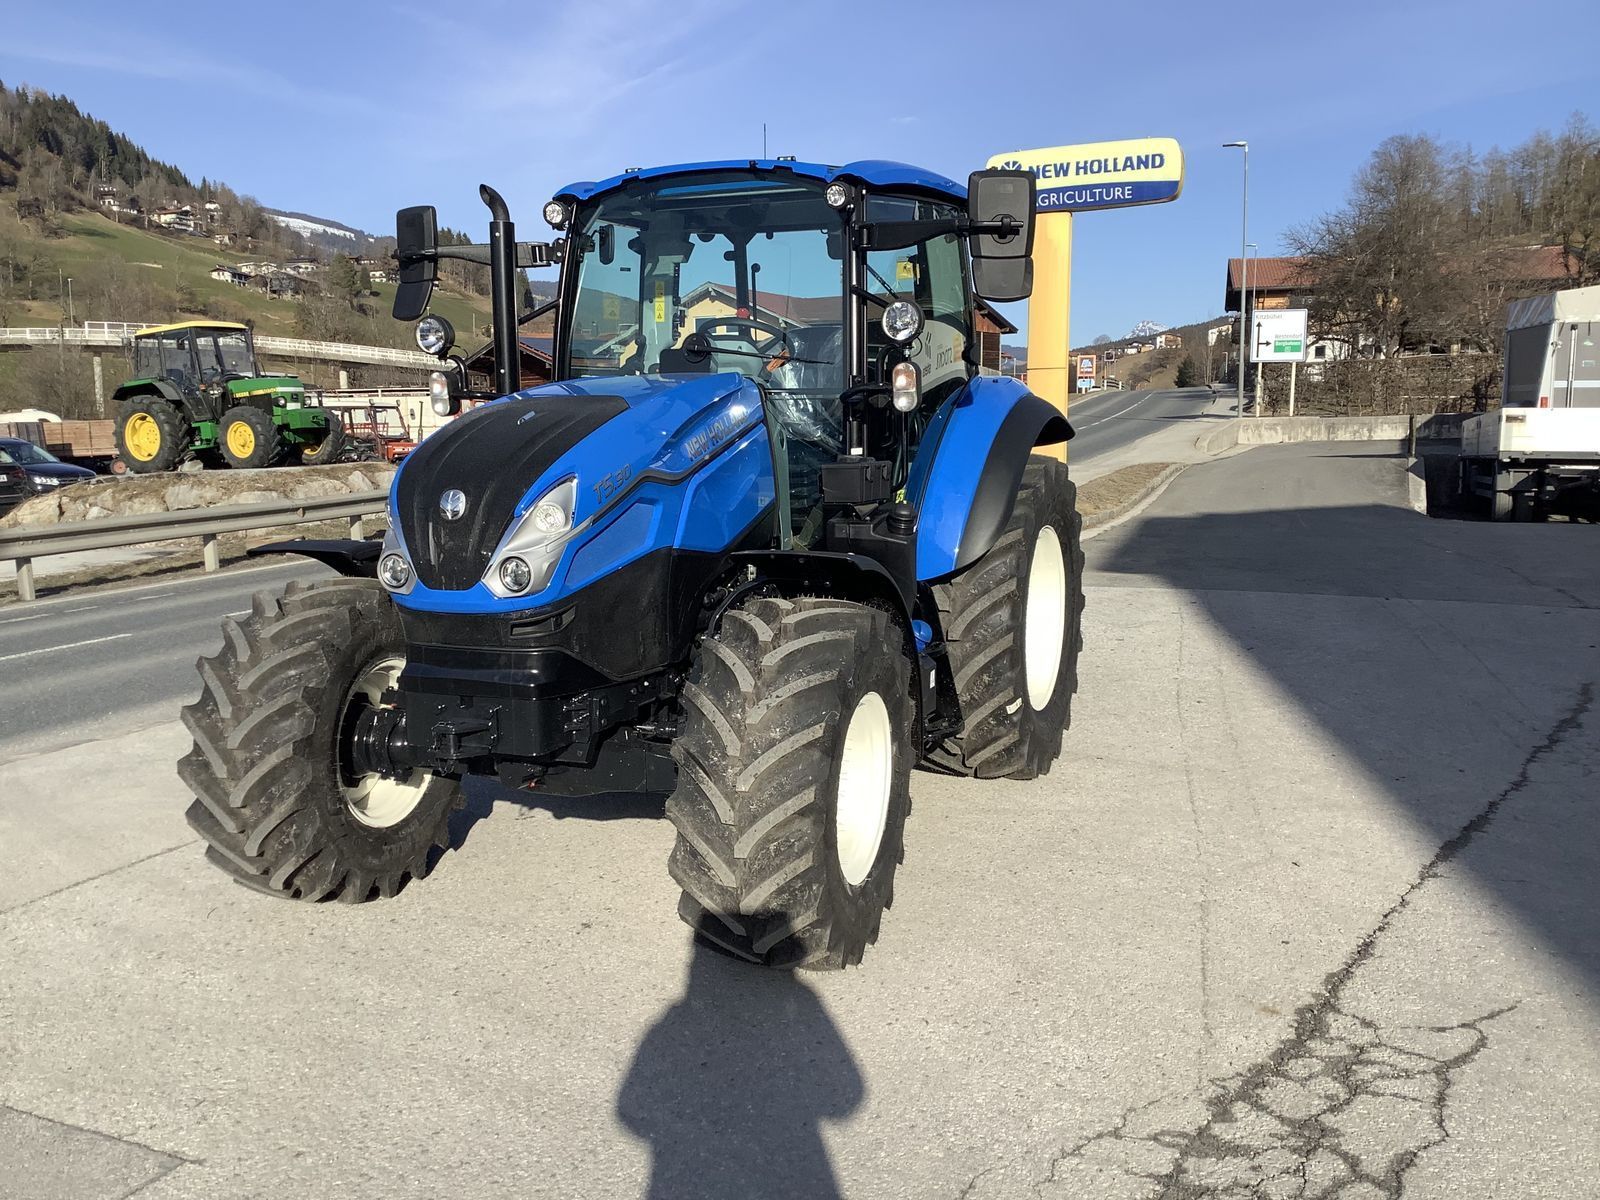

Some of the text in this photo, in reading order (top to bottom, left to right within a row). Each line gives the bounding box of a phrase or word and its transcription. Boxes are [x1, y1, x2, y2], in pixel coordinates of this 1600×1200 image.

[1028, 153, 1165, 179] NEW HOLLAND
[1036, 186, 1133, 207] GRICULTURE
[684, 432, 709, 461] NEW
